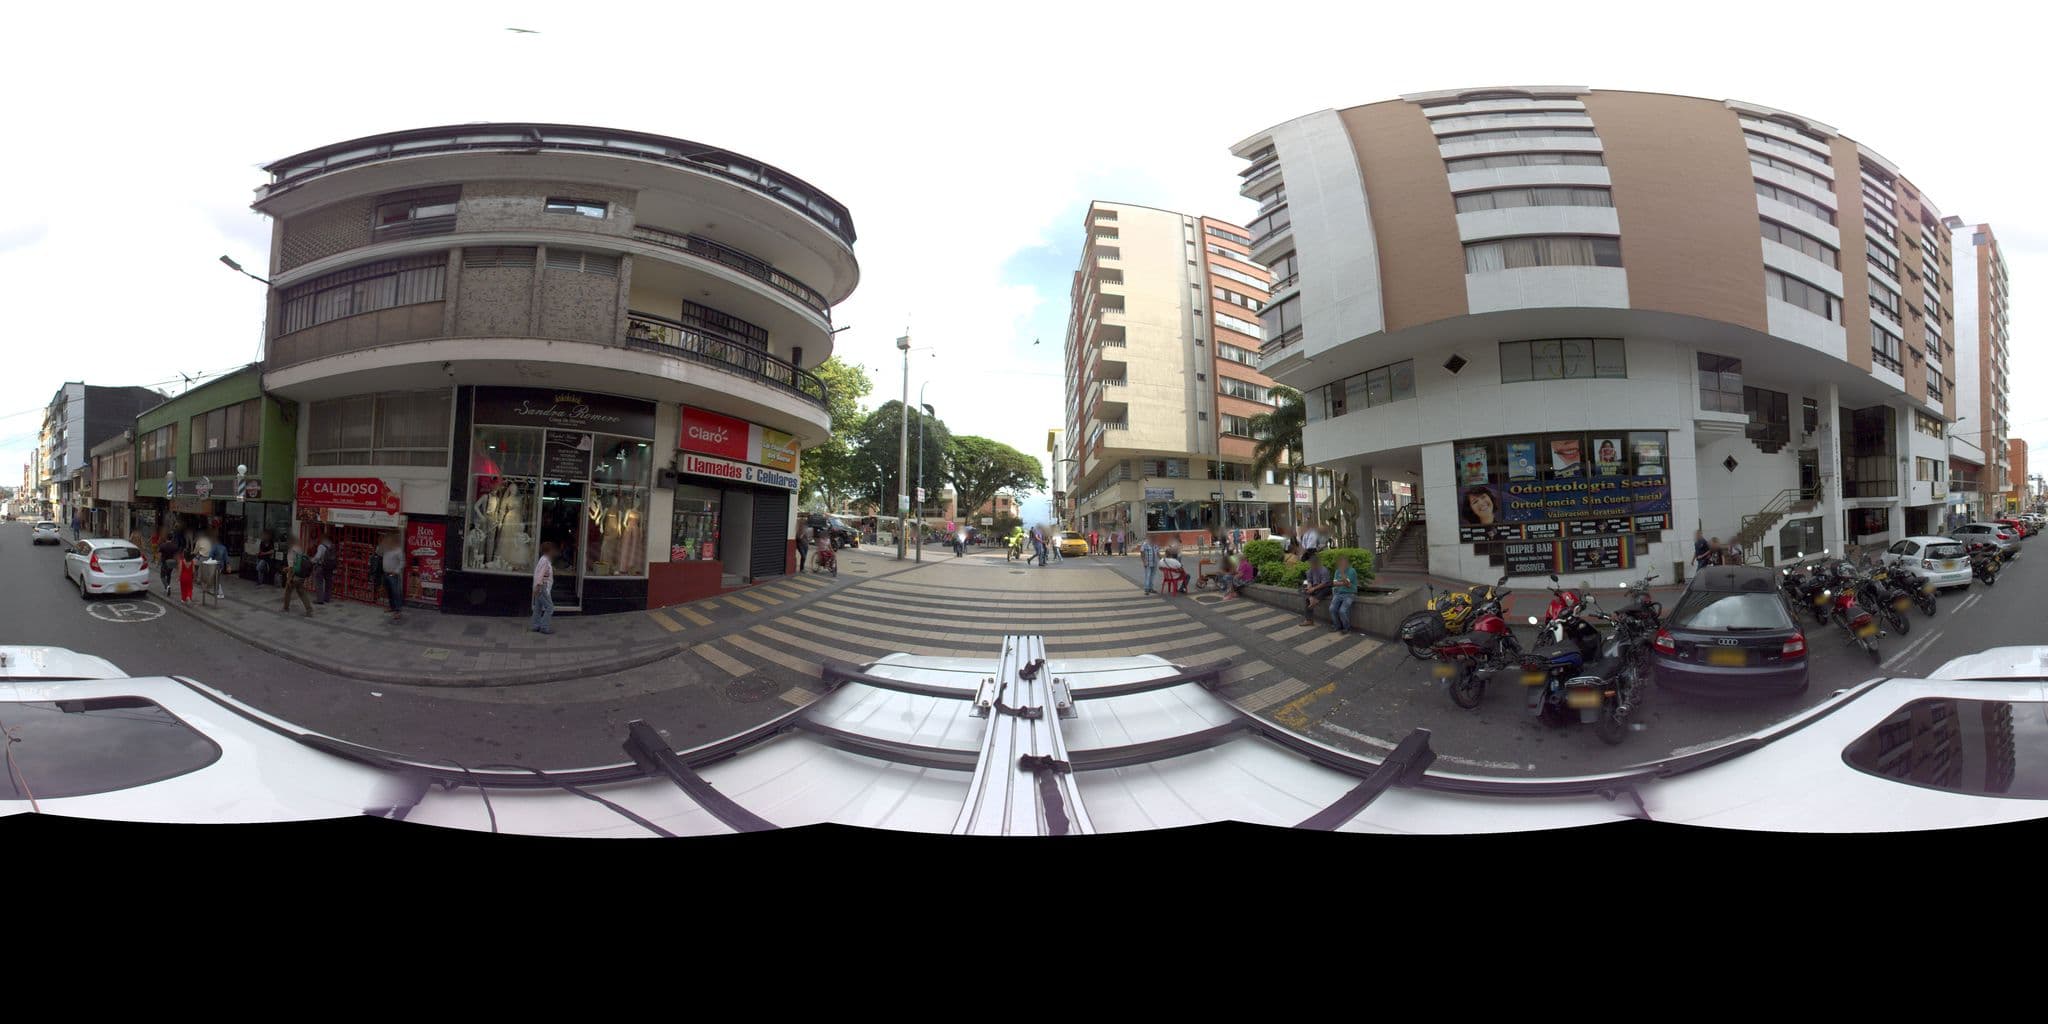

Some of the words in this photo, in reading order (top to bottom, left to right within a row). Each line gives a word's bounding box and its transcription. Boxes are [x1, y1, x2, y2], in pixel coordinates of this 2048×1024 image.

[514, 400, 566, 417] Sandra
[568, 404, 623, 423] Romero
[688, 426, 723, 443] Claro
[687, 456, 742, 479] Llamadas
[746, 467, 753, 481] &
[756, 469, 798, 488] Celulares
[313, 483, 378, 495] CALIDOSO
[1621, 478, 1666, 489] Social
[1511, 497, 1576, 510] Ortodoncia
[1527, 524, 1546, 532] CHIPRE
[408, 536, 442, 548] CALDAS
[1572, 539, 1600, 549] CHIPRE
[1602, 538, 1619, 547] BAR
[1505, 544, 1535, 554] CHIPRE
[1536, 543, 1553, 553] BAR
